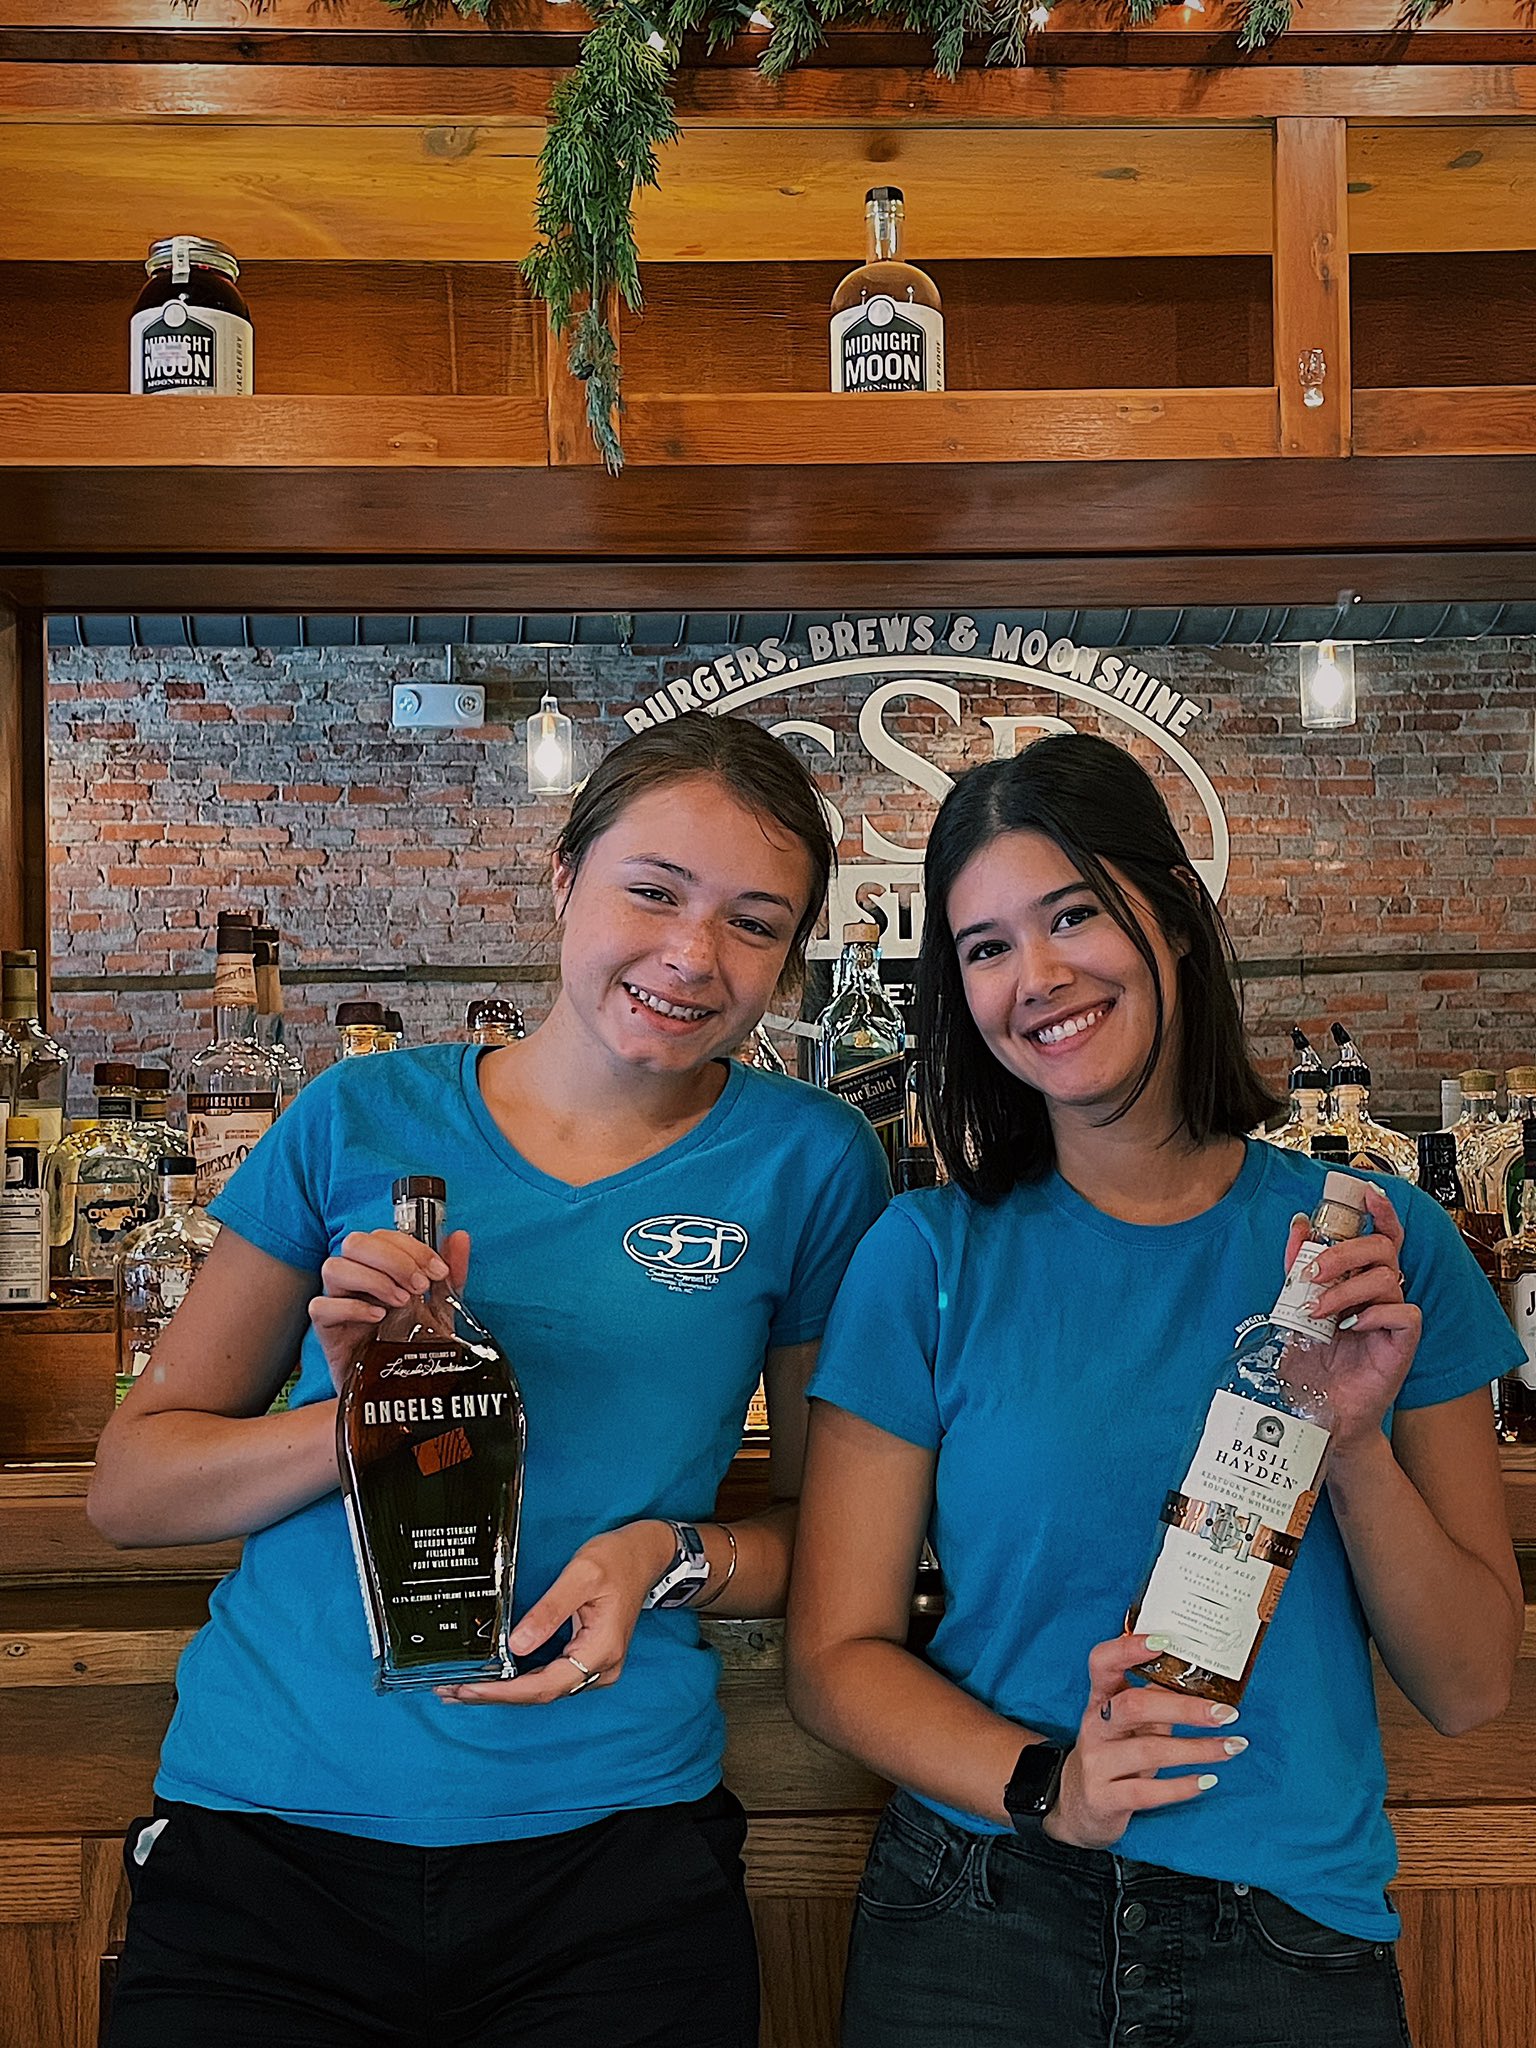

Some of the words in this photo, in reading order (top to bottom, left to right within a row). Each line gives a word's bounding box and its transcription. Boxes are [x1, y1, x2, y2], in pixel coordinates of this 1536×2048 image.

[844, 332, 921, 358] MIDNIGHT
[146, 378, 208, 388] MOONSHINE
[845, 352, 921, 388] MOON
[807, 615, 935, 662] BREWS
[948, 616, 979, 652] &
[990, 622, 1203, 738] MOONSHINE
[838, 1089, 863, 1103] lue
[364, 1397, 445, 1425] ANGELS
[451, 1393, 504, 1419] ENVY
[1215, 1450, 1295, 1490] HAYDEN
[1231, 1439, 1290, 1472] BASIL
